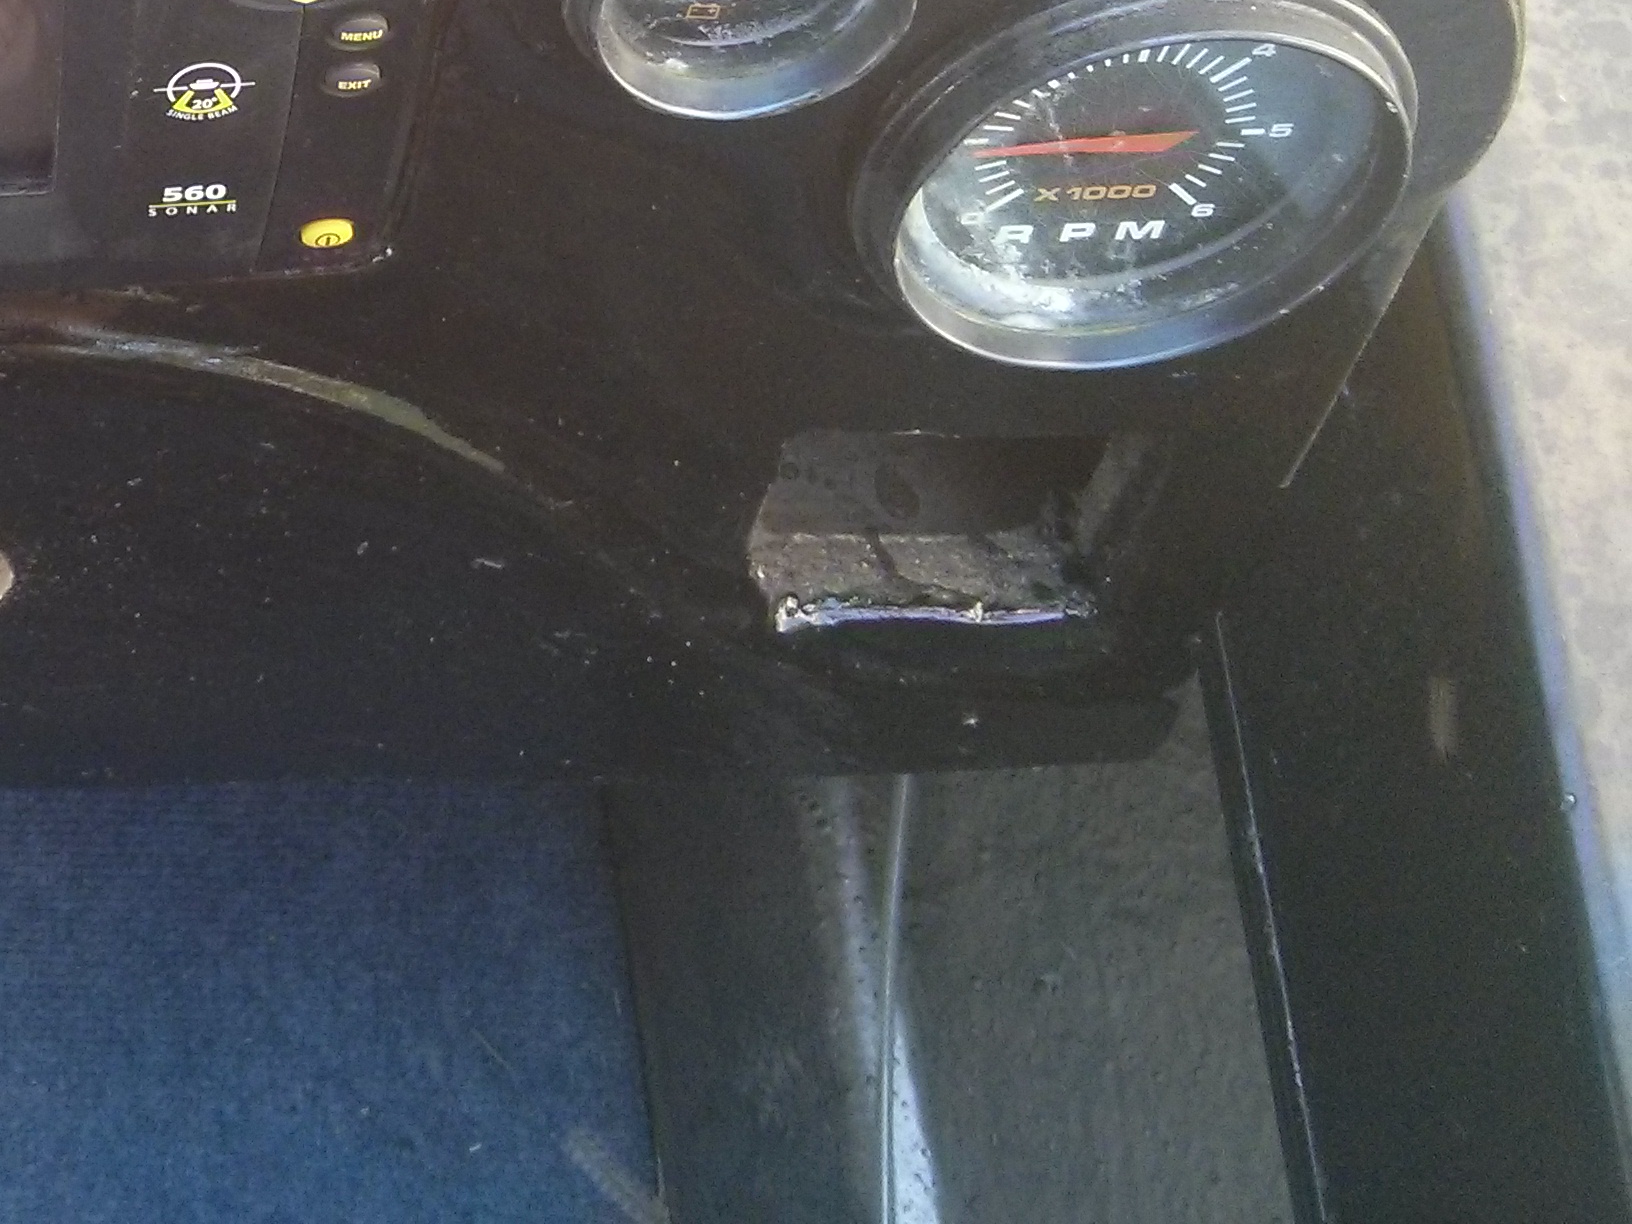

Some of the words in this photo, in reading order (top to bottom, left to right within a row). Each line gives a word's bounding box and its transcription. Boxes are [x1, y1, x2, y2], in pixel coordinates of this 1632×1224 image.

[340, 29, 384, 41] MENU
[1251, 43, 1277, 57] 4
[338, 79, 372, 90] EXIT
[1269, 123, 1294, 138] 5
[162, 183, 228, 202] 560
[148, 203, 237, 217] SONAR
[1191, 203, 1216, 218] 6
